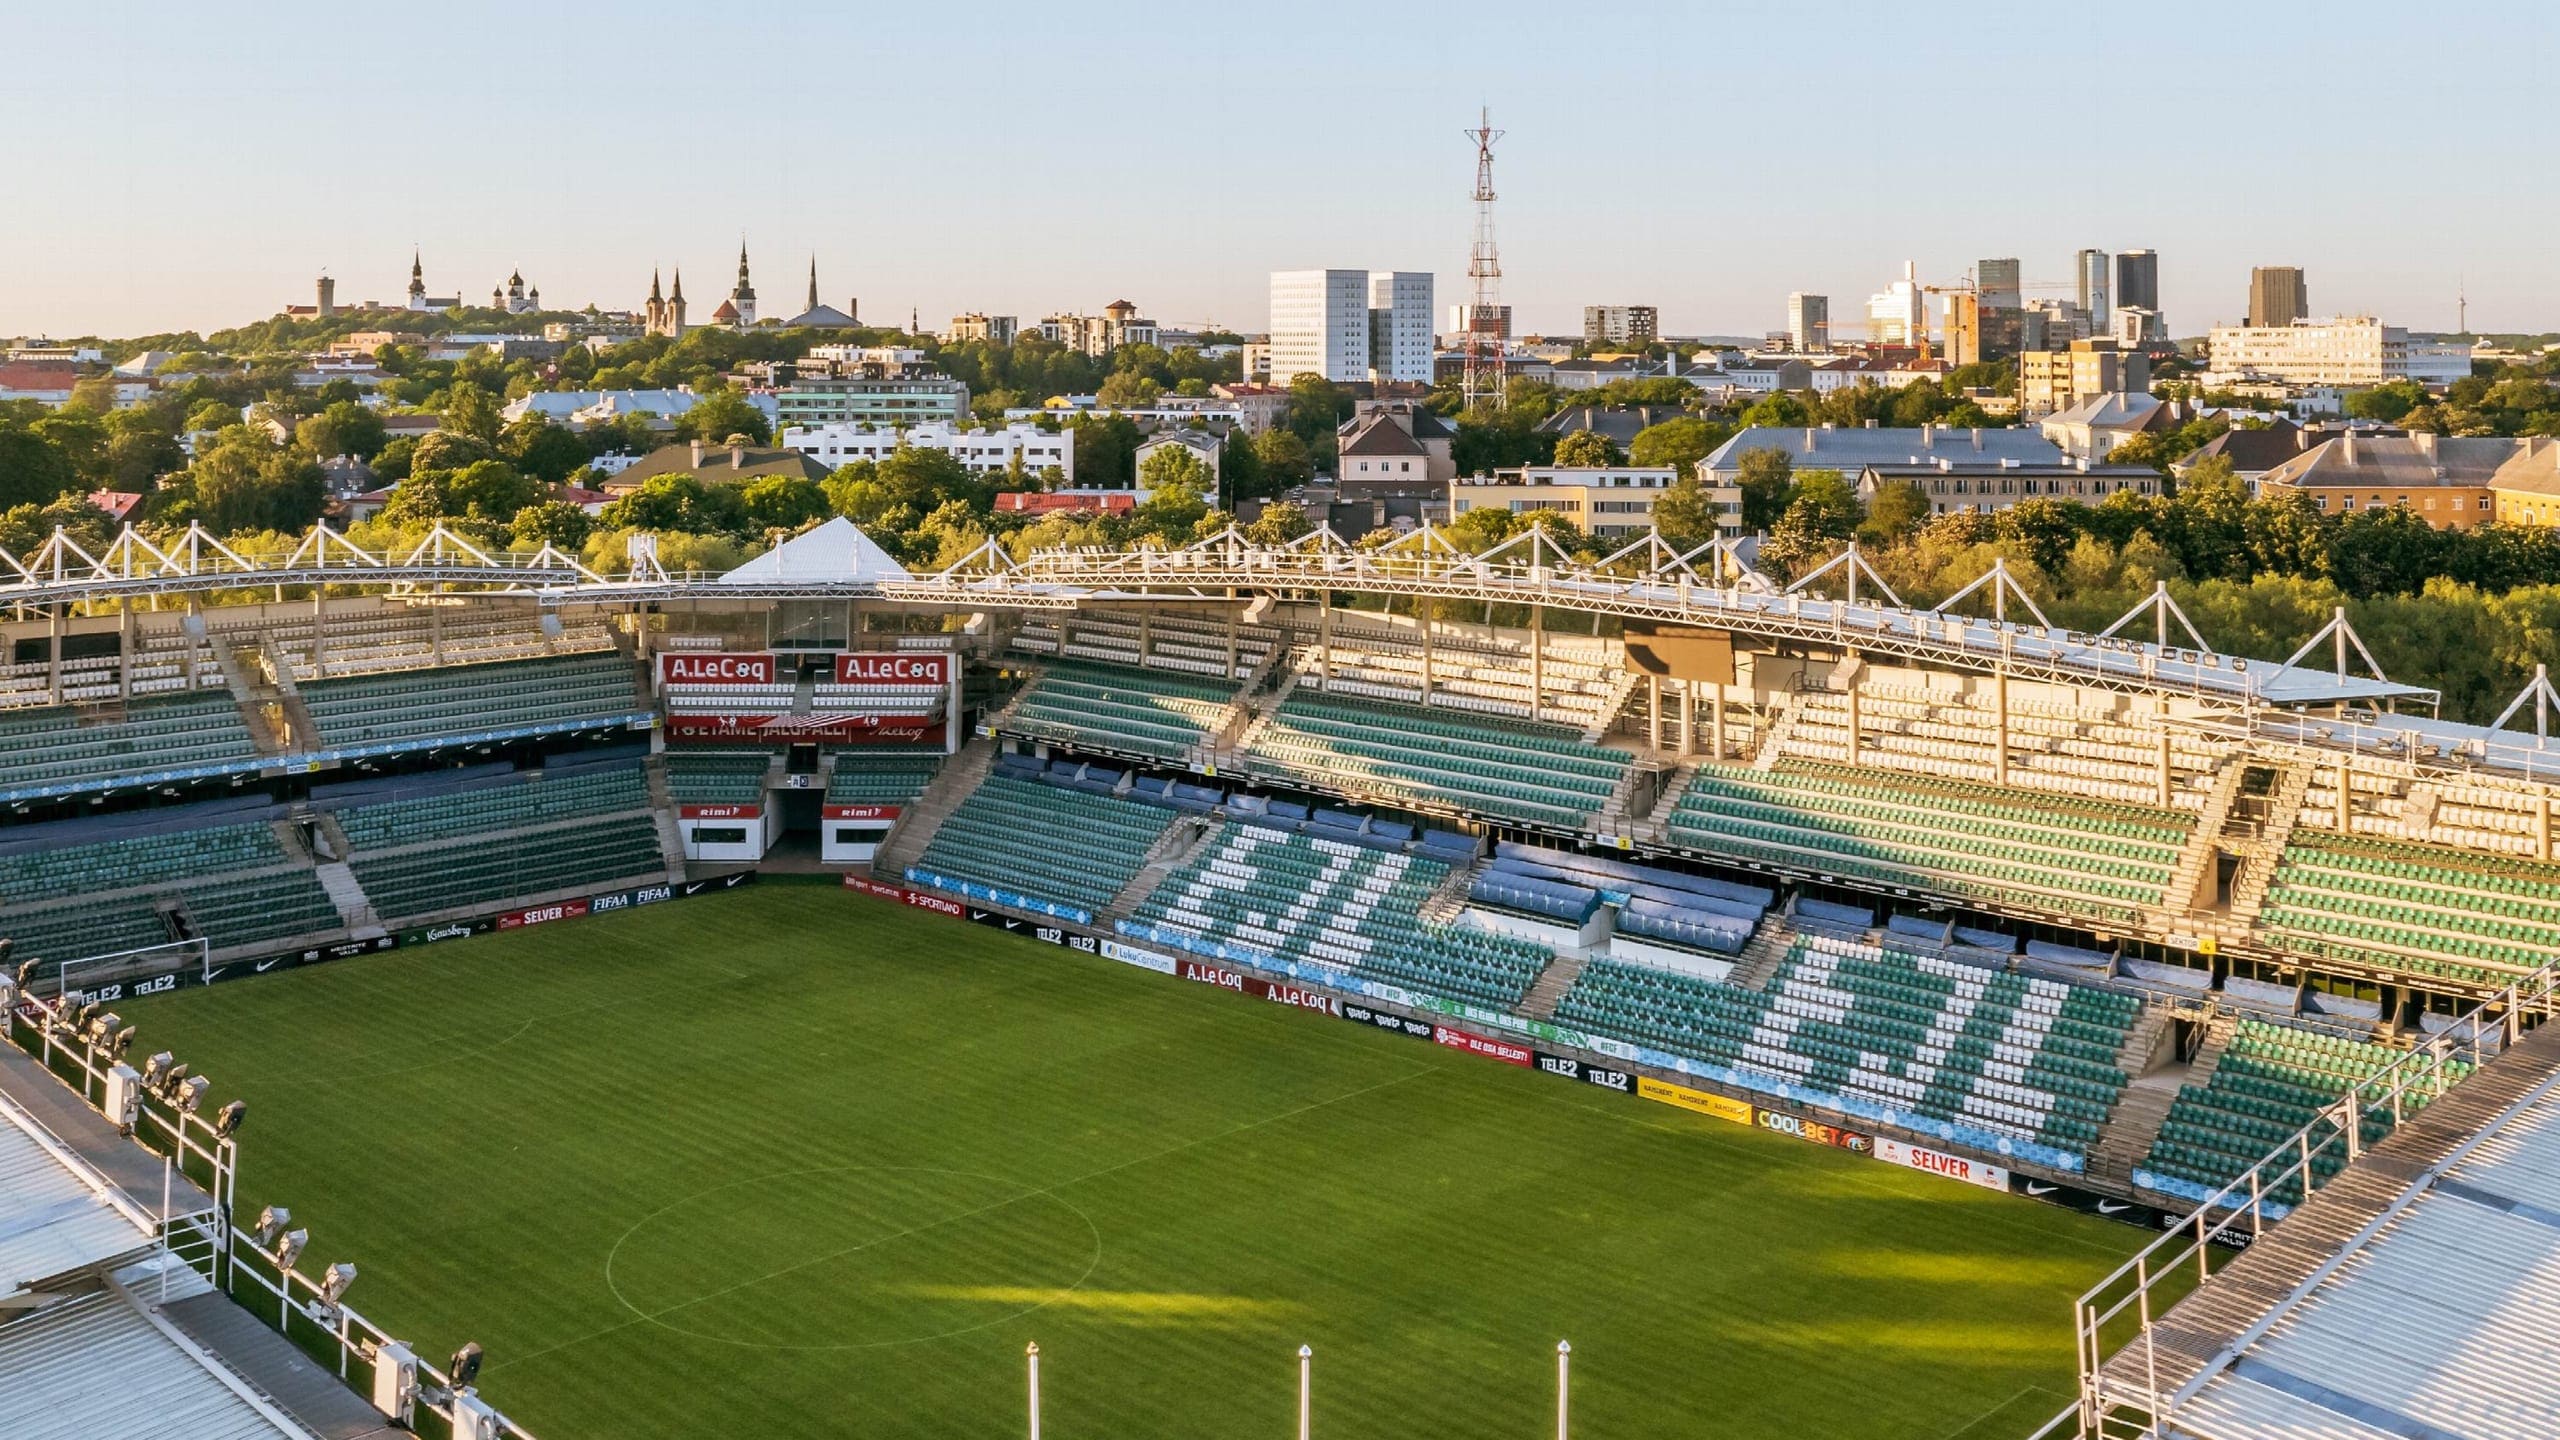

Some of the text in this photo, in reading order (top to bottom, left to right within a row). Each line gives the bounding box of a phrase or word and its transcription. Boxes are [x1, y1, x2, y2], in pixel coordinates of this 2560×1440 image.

[594, 894, 628, 911] FIFAA
[637, 887, 671, 903] FIFAA
[919, 895, 960, 915] SPORTLAND
[524, 906, 563, 925] SELVER
[1036, 927, 1062, 945] TELE2
[1069, 936, 1096, 953] TELE2
[134, 974, 176, 996] TELE2
[1540, 1057, 1578, 1078] TELE2
[1588, 1069, 1628, 1091] TELE2
[1758, 1110, 1840, 1145] COOLBET
[1911, 1149, 1970, 1179] SELVER
